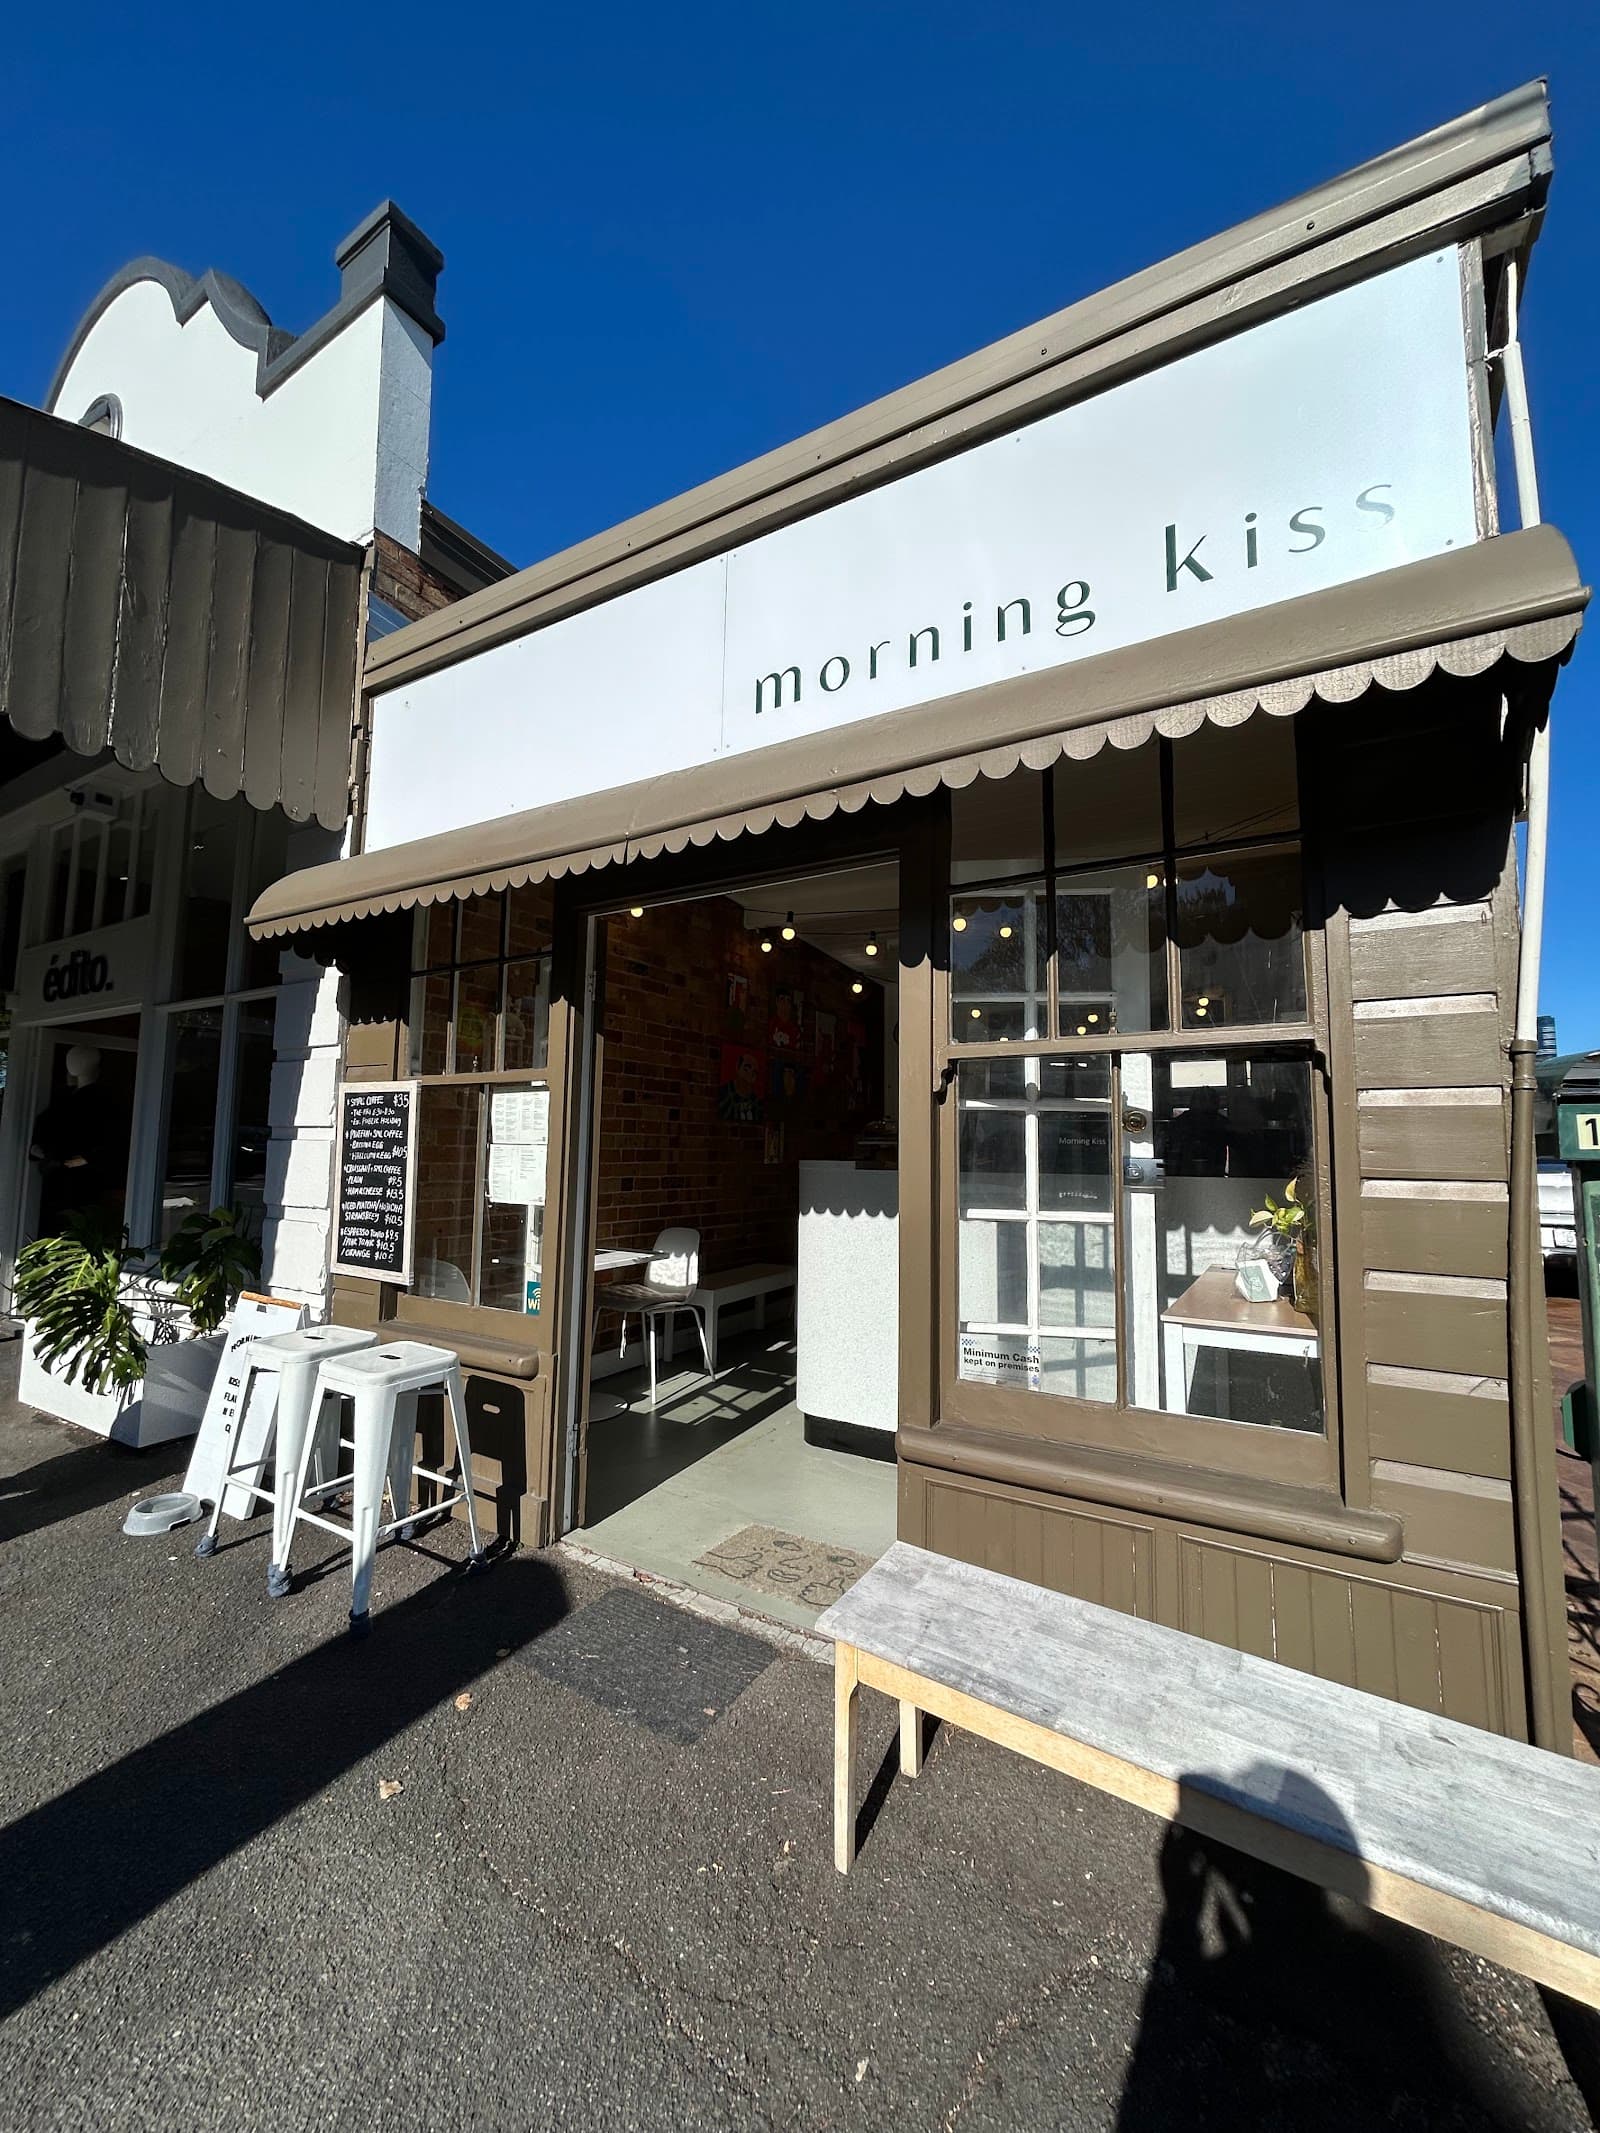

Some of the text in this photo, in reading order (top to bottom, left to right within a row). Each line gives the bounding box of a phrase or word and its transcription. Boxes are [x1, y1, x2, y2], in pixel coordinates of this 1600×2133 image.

[755, 484, 1396, 714] morning kiss
[43, 949, 114, 1002] édito.
[383, 1129, 404, 1139] COFFEE
[1585, 1118, 1598, 1146] 1
[1058, 1137, 1090, 1146] Morning
[383, 1165, 402, 1175] COFFEE
[963, 1347, 1040, 1364] Minimum Cash
[963, 1357, 983, 1366] kept
[998, 1362, 1040, 1373] premises
